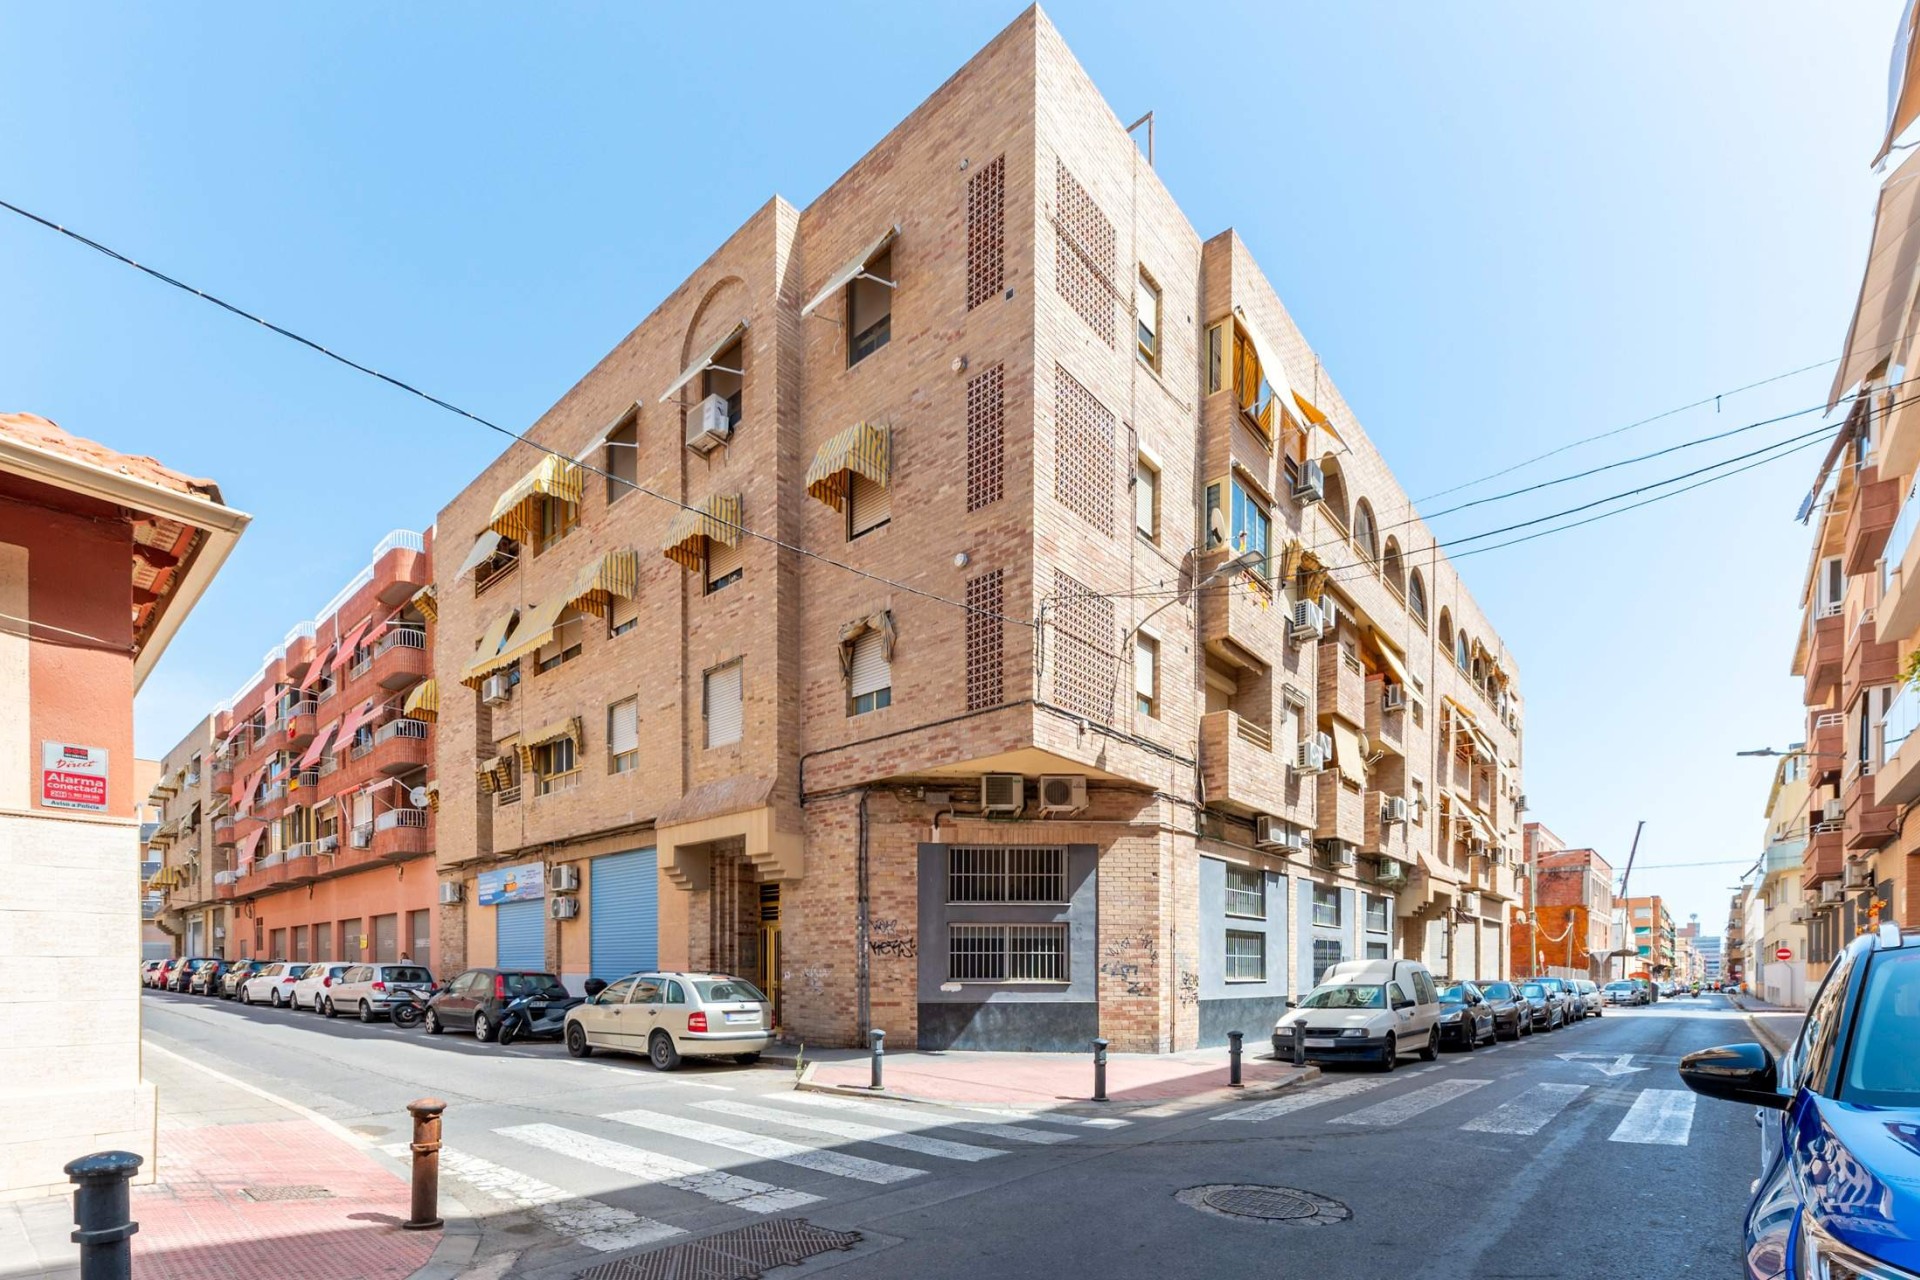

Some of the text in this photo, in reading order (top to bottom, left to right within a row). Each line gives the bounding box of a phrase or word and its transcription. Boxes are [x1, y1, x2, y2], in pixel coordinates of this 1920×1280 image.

[56, 759, 98, 768] Direct
[48, 772, 103, 787] Alarma
[47, 782, 103, 794] conectada
